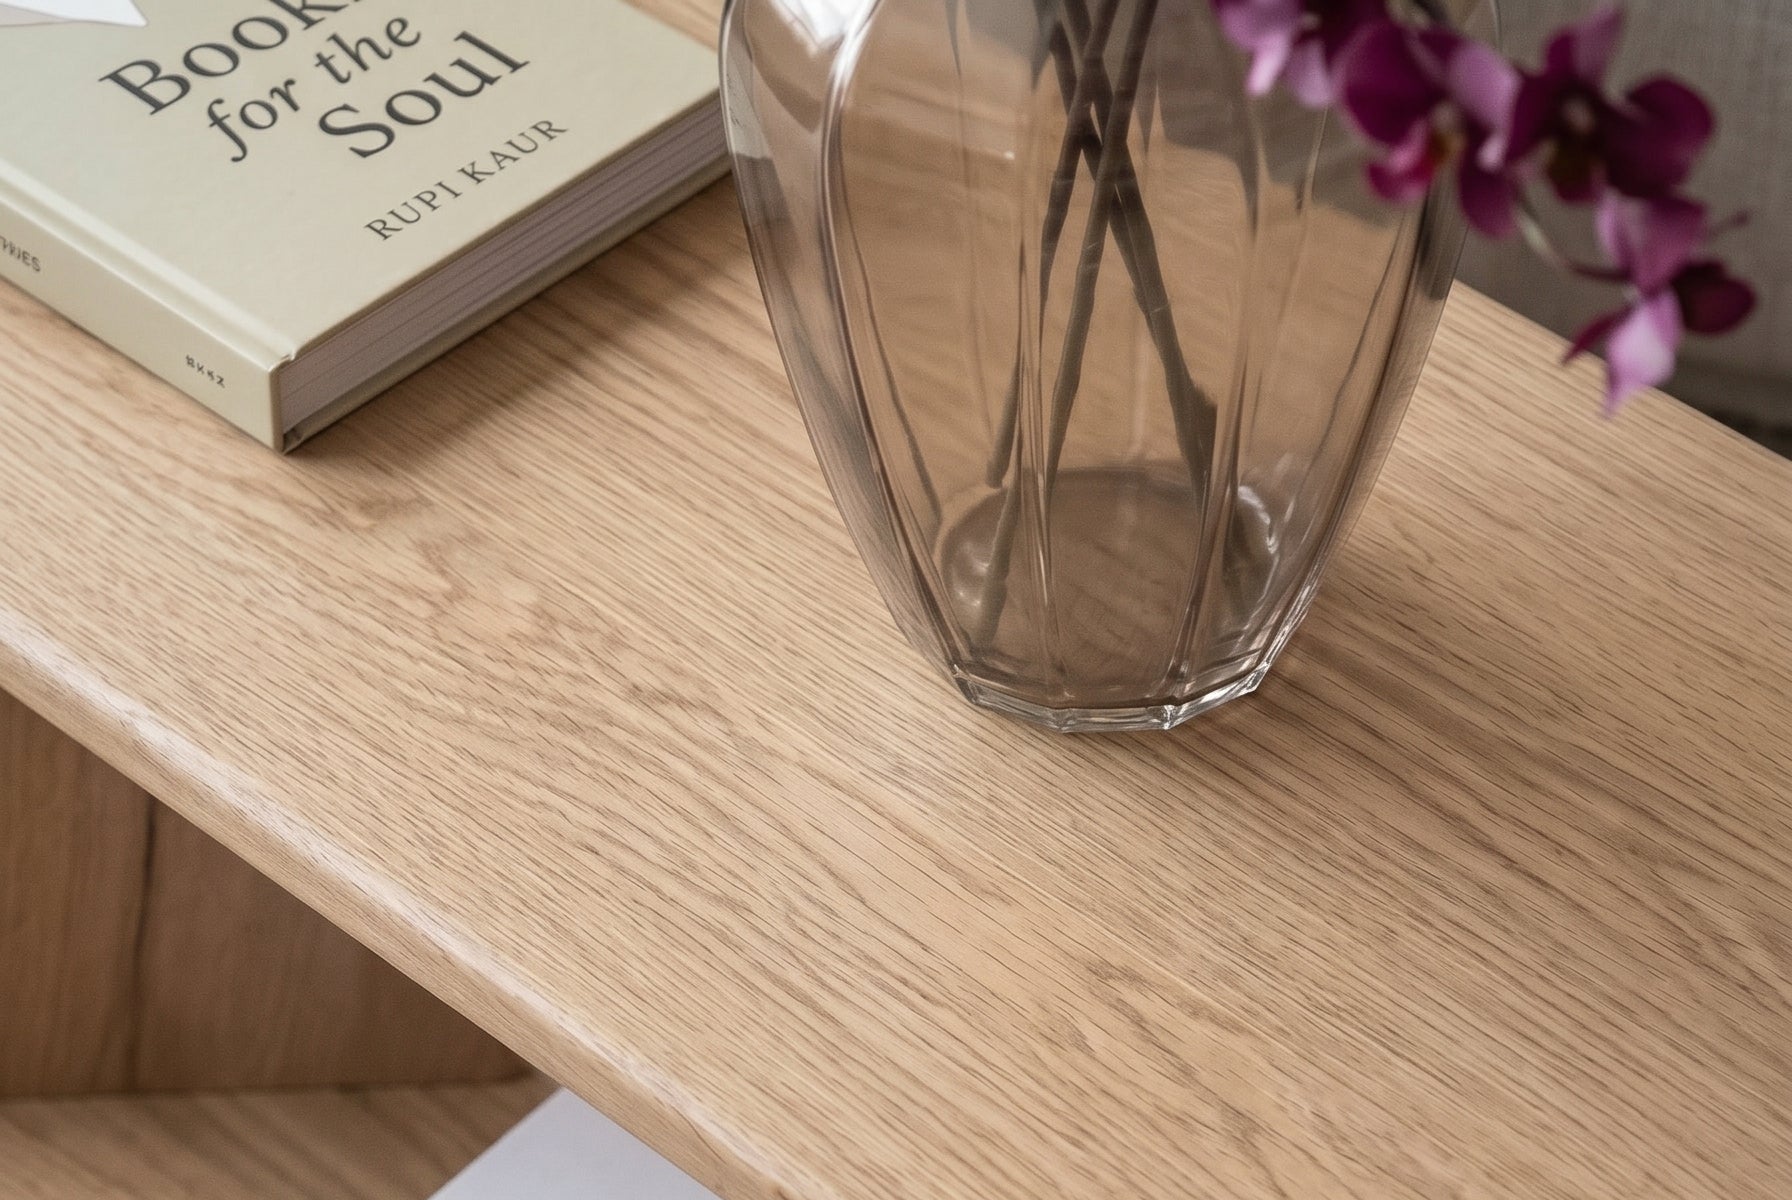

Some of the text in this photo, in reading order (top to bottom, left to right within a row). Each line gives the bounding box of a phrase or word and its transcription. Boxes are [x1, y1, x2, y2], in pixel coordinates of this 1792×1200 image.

[98, 0, 361, 116] Book
[206, 17, 422, 163] for the
[317, 30, 531, 159] Soul
[364, 119, 569, 241] RUPI KAUR
